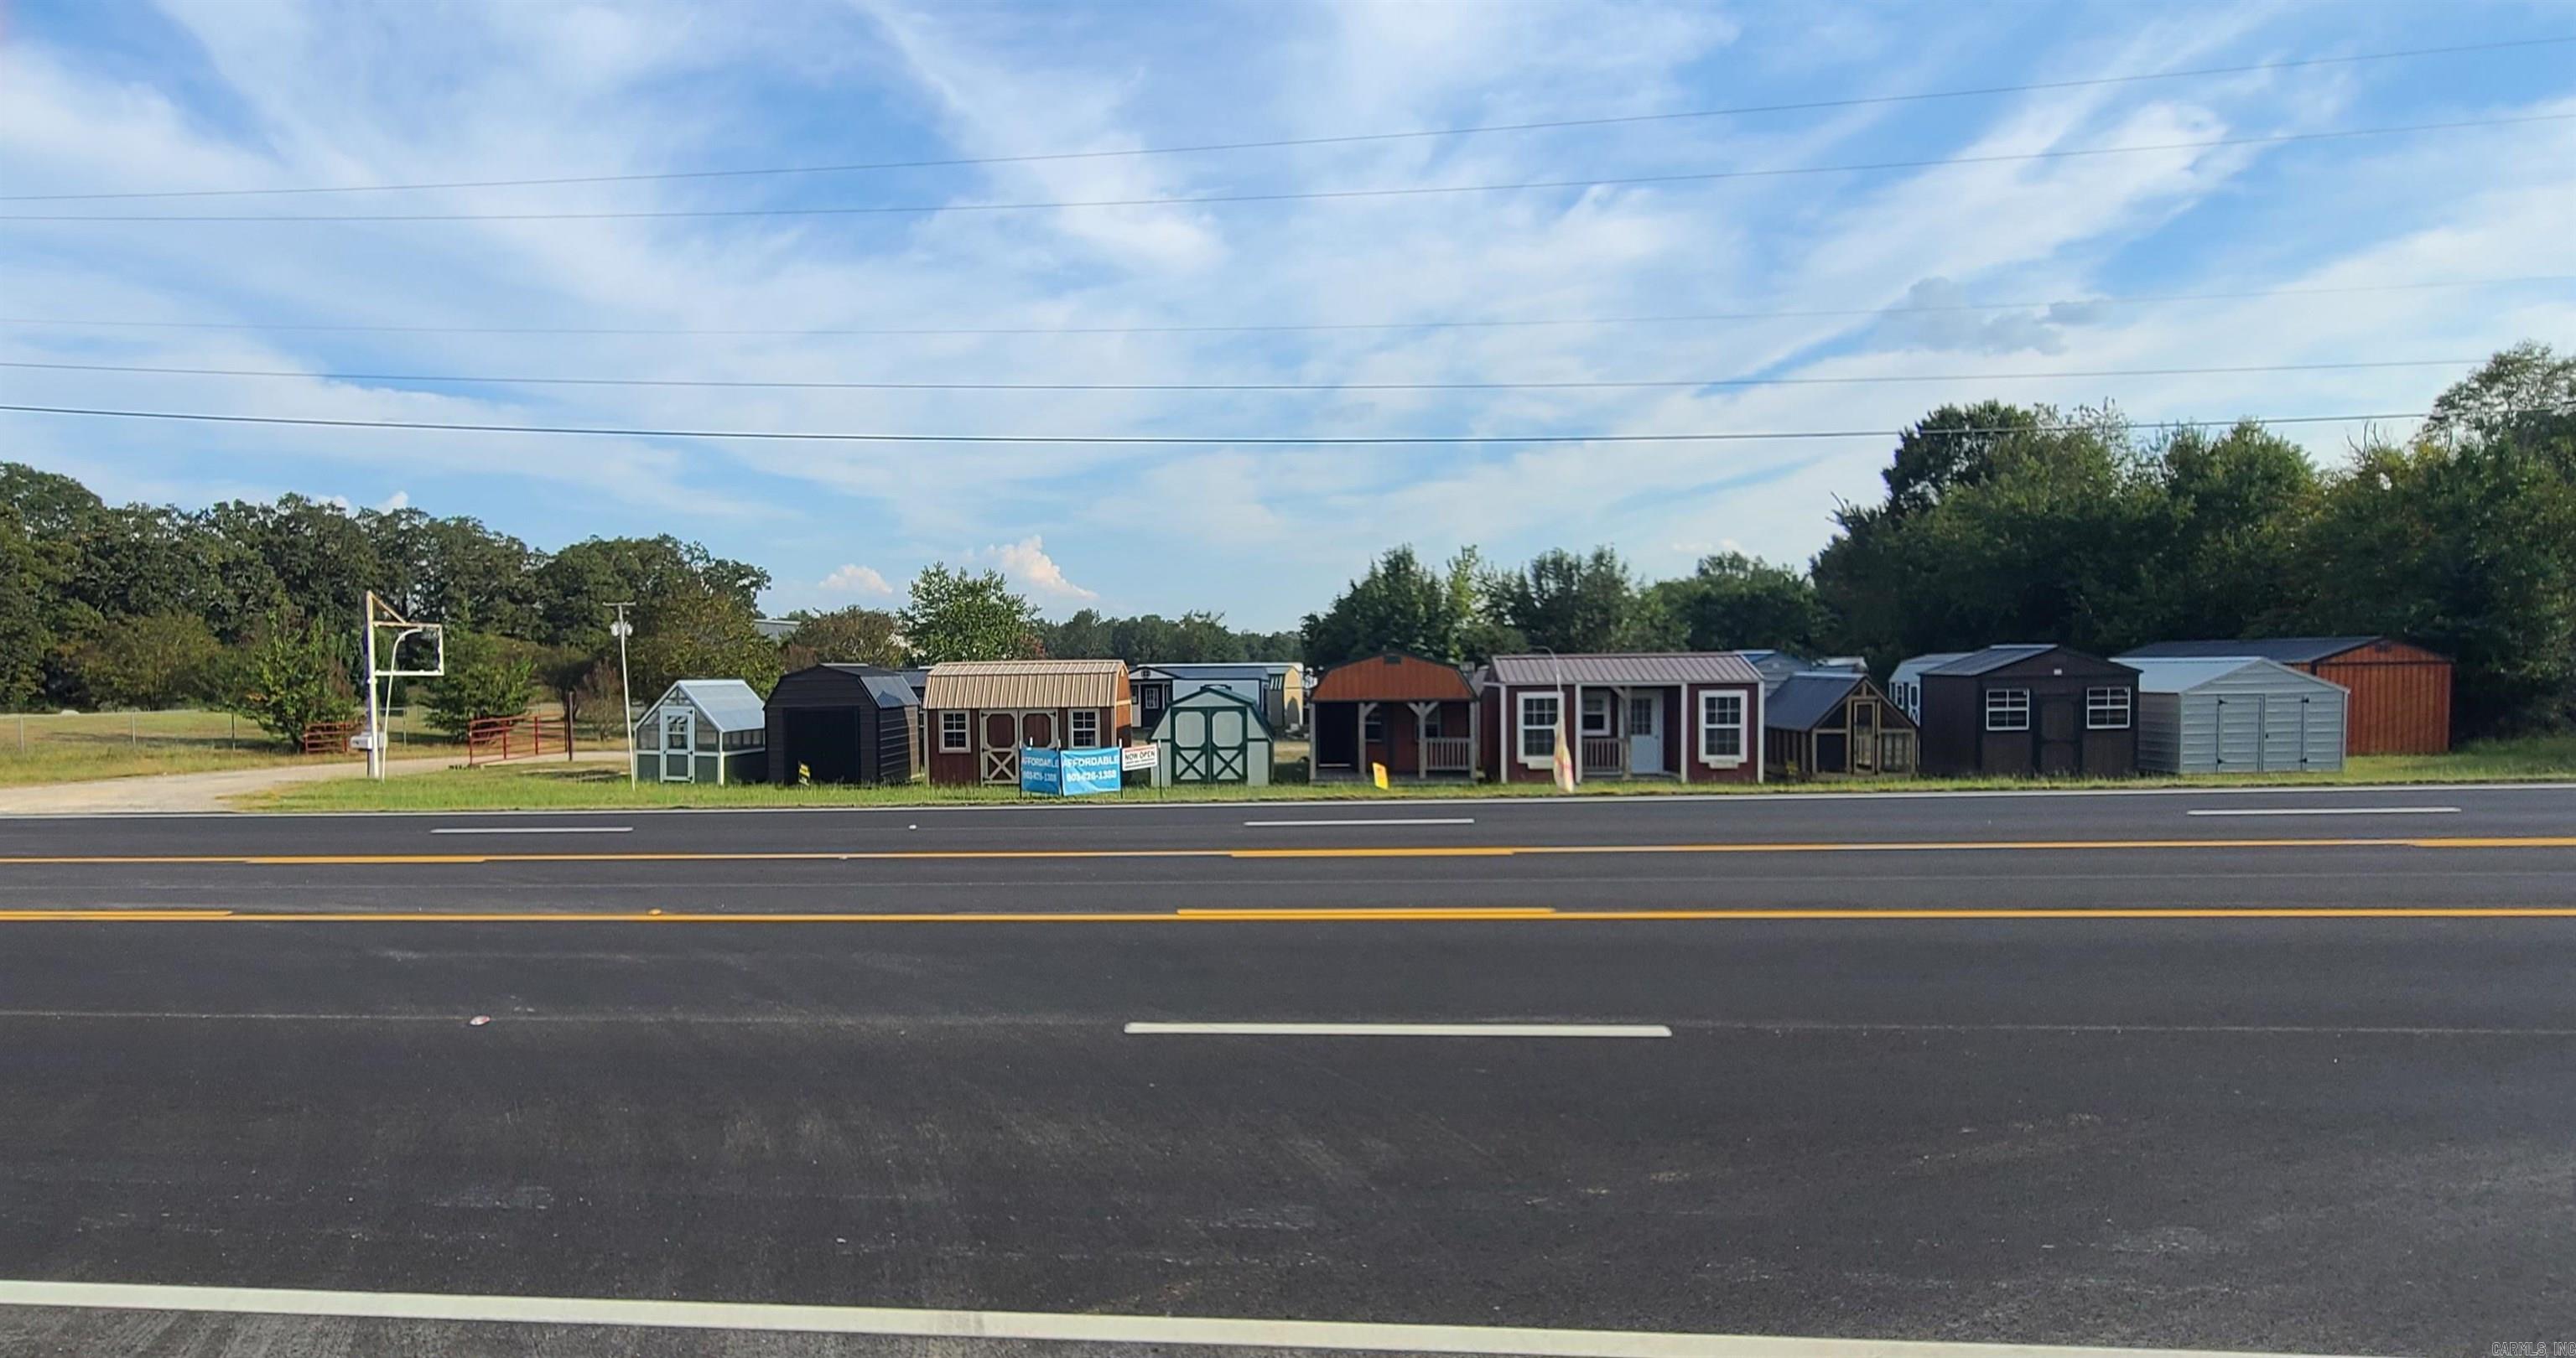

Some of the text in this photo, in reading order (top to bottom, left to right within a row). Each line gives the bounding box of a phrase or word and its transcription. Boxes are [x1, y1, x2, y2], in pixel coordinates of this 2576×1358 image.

[1062, 755, 1119, 767] AFFORDABLE
[1124, 753, 1139, 761] NOW
[1140, 750, 1156, 759] OPEN
